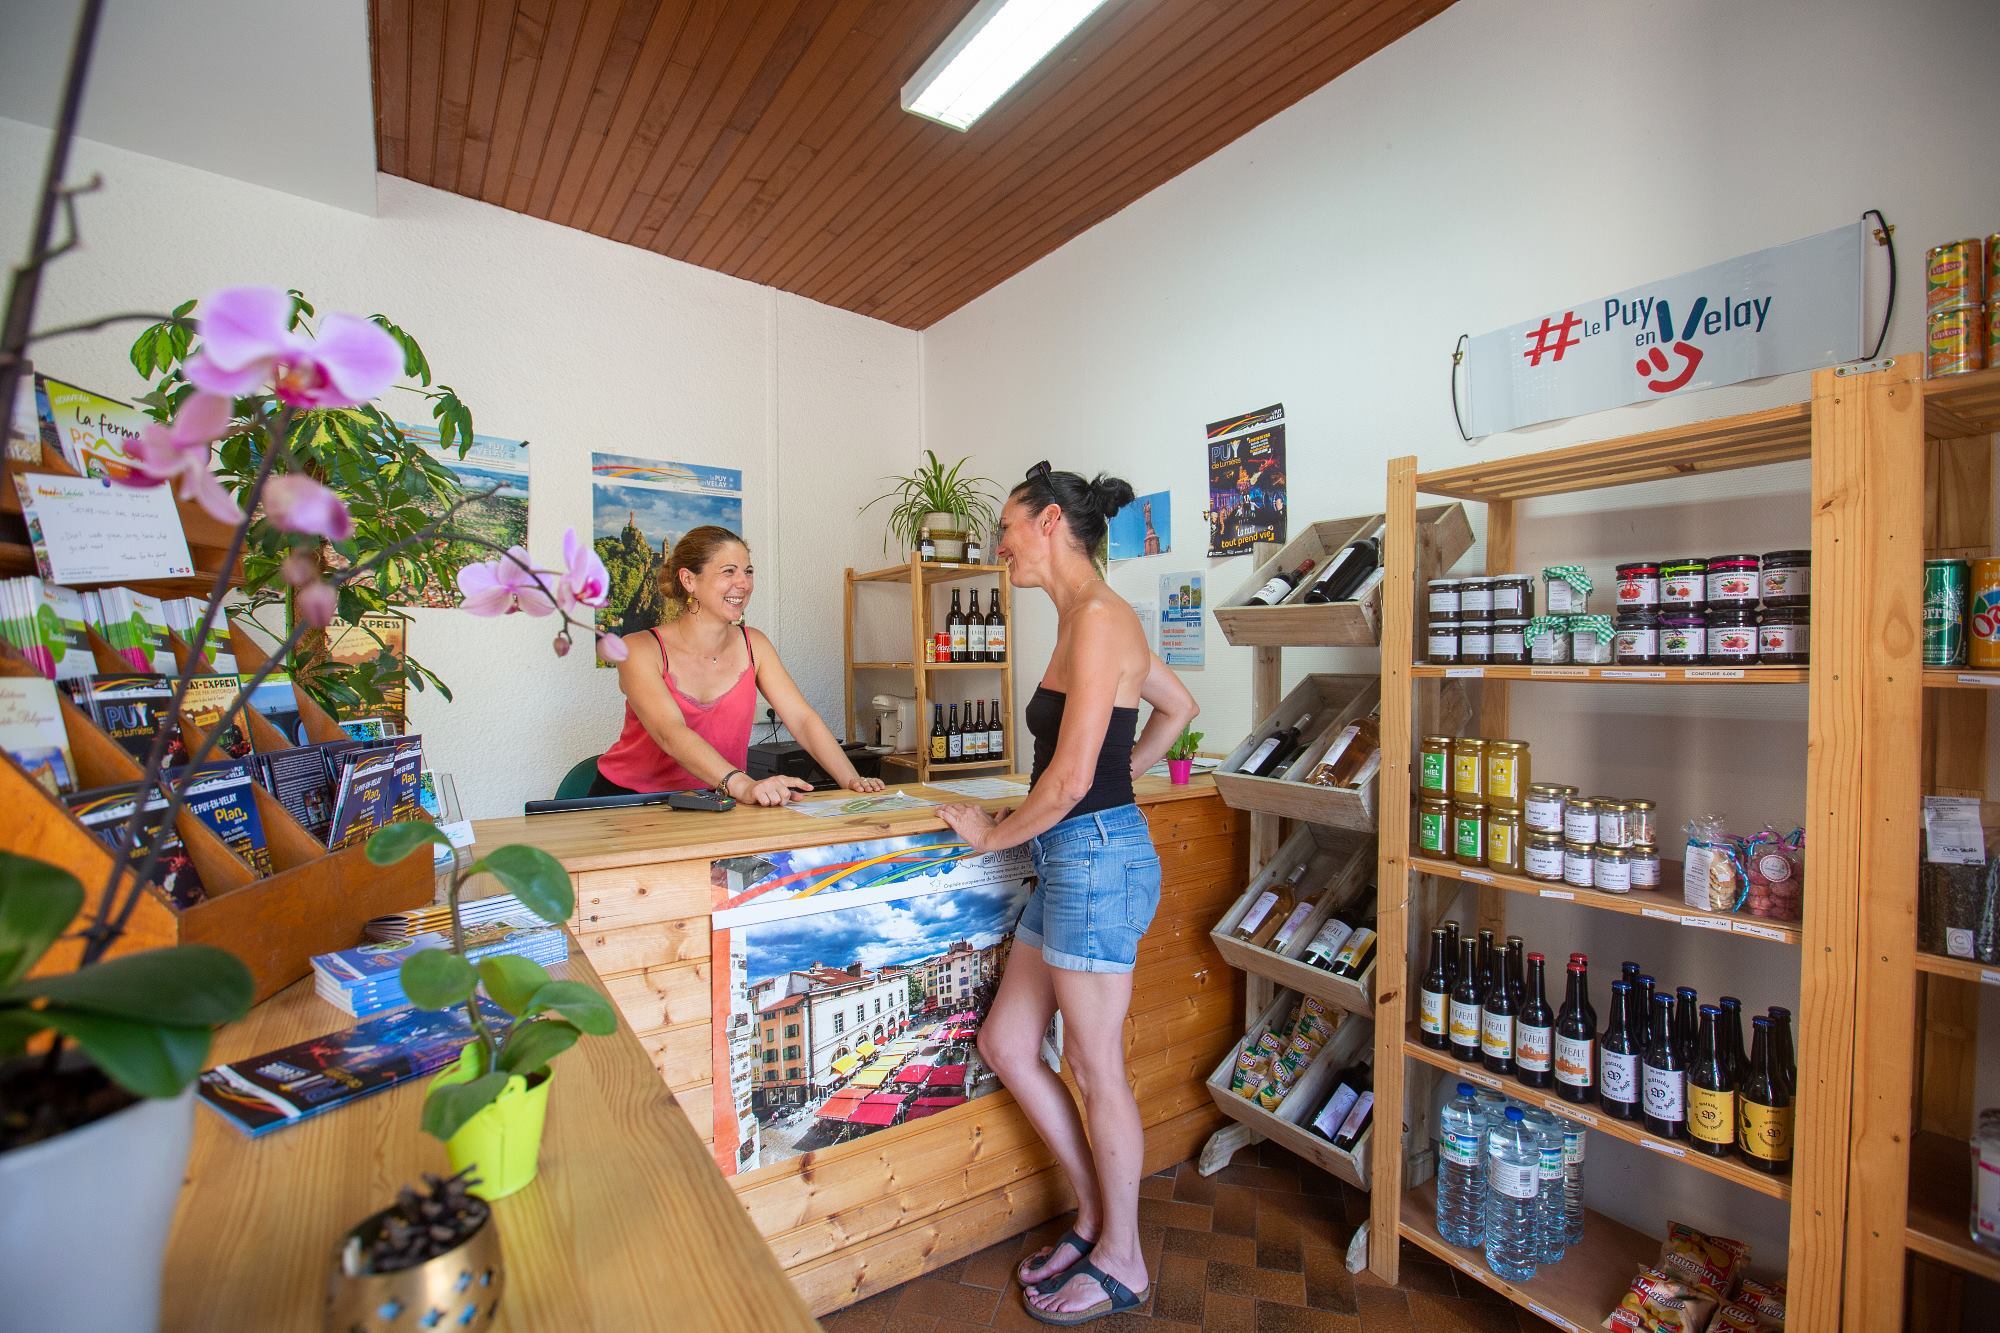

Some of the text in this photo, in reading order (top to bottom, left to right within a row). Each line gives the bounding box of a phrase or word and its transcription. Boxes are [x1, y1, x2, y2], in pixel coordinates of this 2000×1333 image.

[1605, 297, 1654, 331] Puy
[1635, 329, 1656, 347] en
[1656, 297, 1772, 343] Velay
[1212, 441, 1241, 463] PUY
[1221, 529, 1271, 549] tout prend vie
[104, 702, 148, 730] PUY
[401, 773, 415, 785] Plan
[1424, 769, 1440, 777] MIEL
[363, 789, 380, 803] Plan
[215, 807, 243, 824] Plan
[1458, 836, 1475, 844] MIEL
[1634, 1277, 1686, 1311] Ancienne
